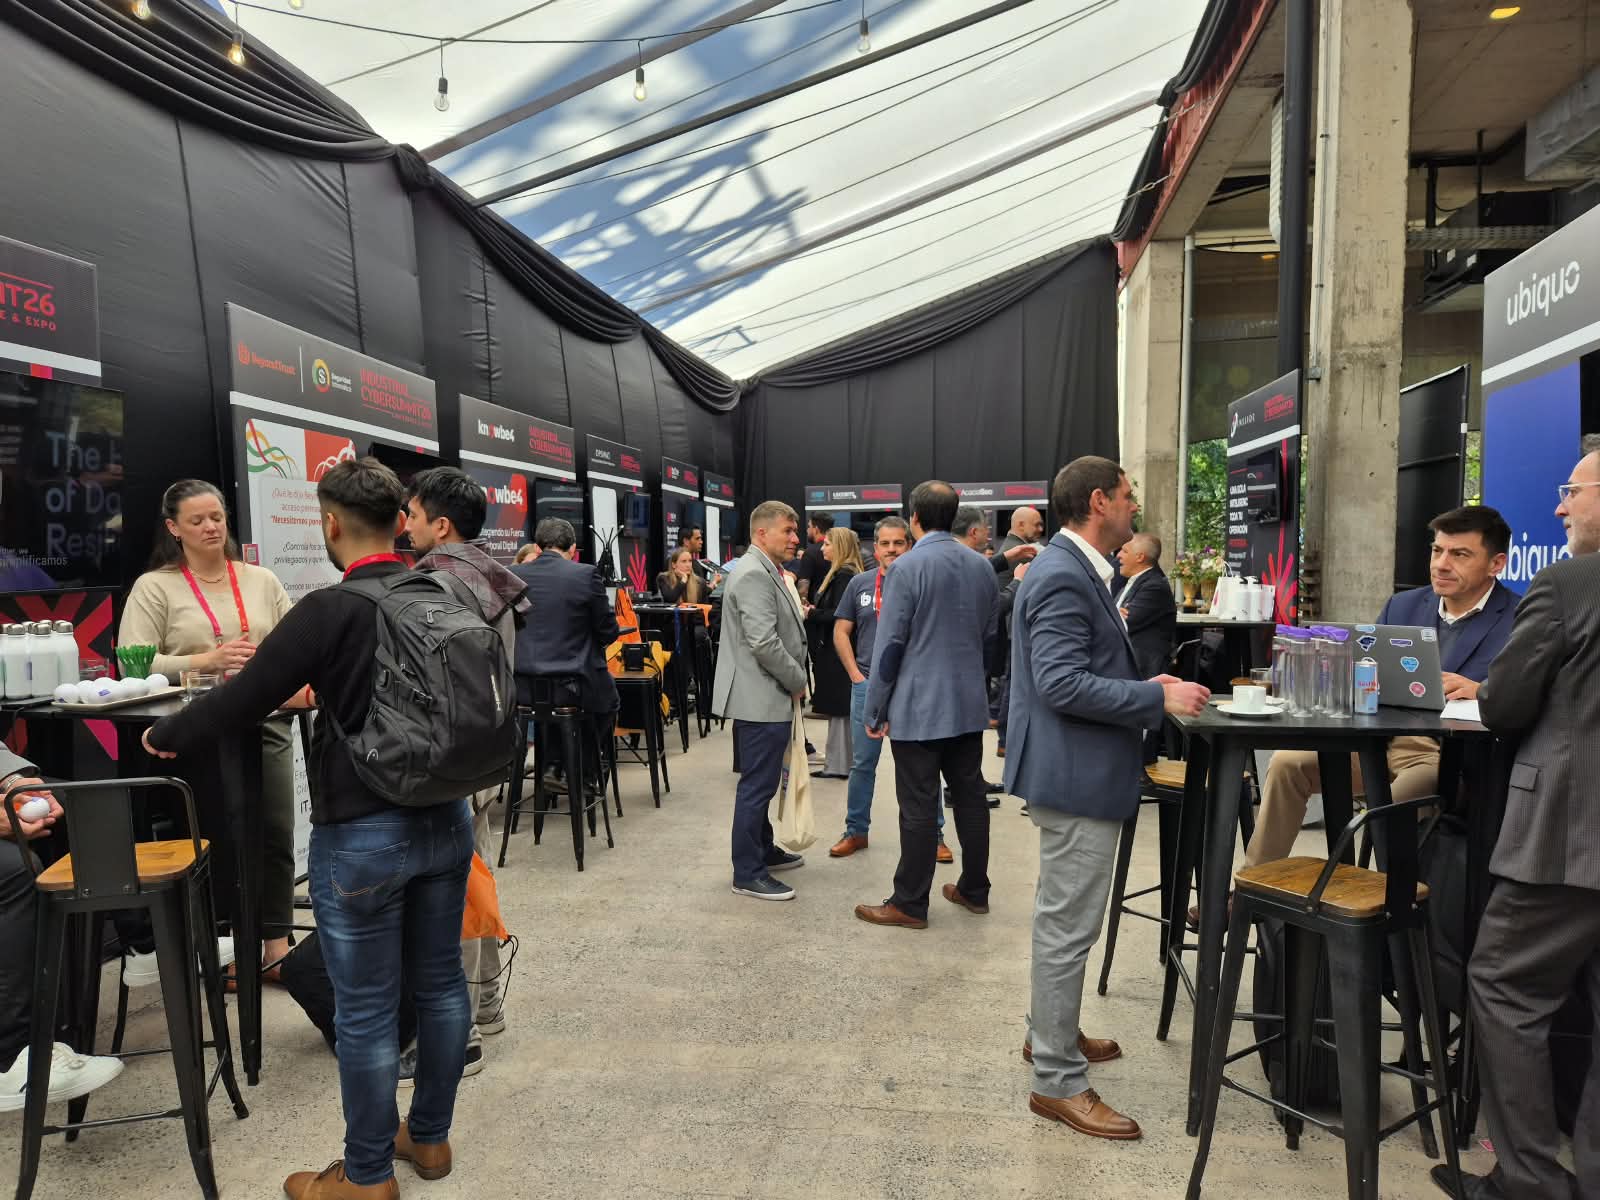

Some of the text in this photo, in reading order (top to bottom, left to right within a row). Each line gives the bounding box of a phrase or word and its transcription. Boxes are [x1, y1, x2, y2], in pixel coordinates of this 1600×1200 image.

[1507, 261, 1580, 325] ubiquo
[26, 315, 57, 331] EXPO
[480, 485, 523, 505] owbe4
[1496, 531, 1573, 581] biqu
